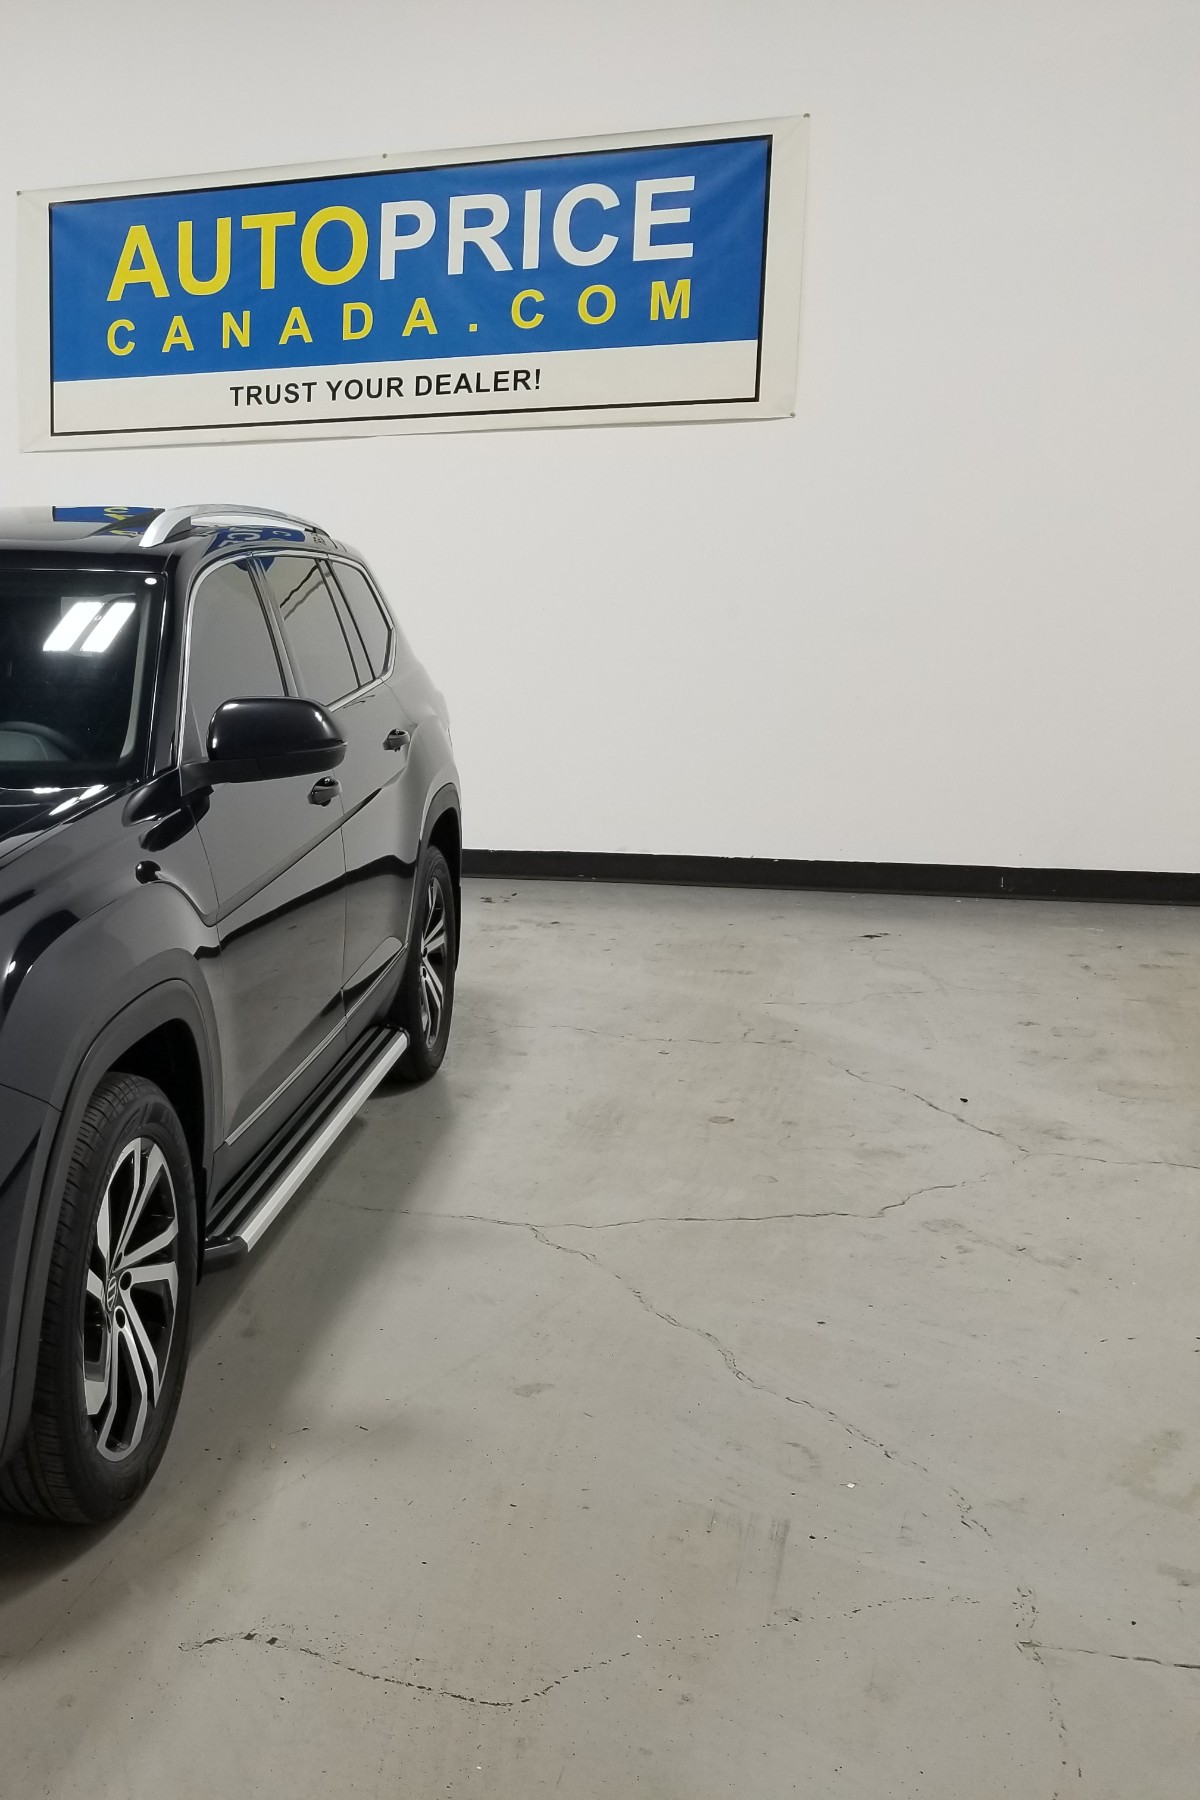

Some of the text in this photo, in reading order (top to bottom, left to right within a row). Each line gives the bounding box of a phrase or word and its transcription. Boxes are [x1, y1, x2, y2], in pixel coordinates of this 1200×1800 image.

[106, 175, 695, 302] AUTOPRICE
[106, 278, 692, 356] CANADA.COM
[229, 368, 542, 407] TRUST YOUR DEALER!
